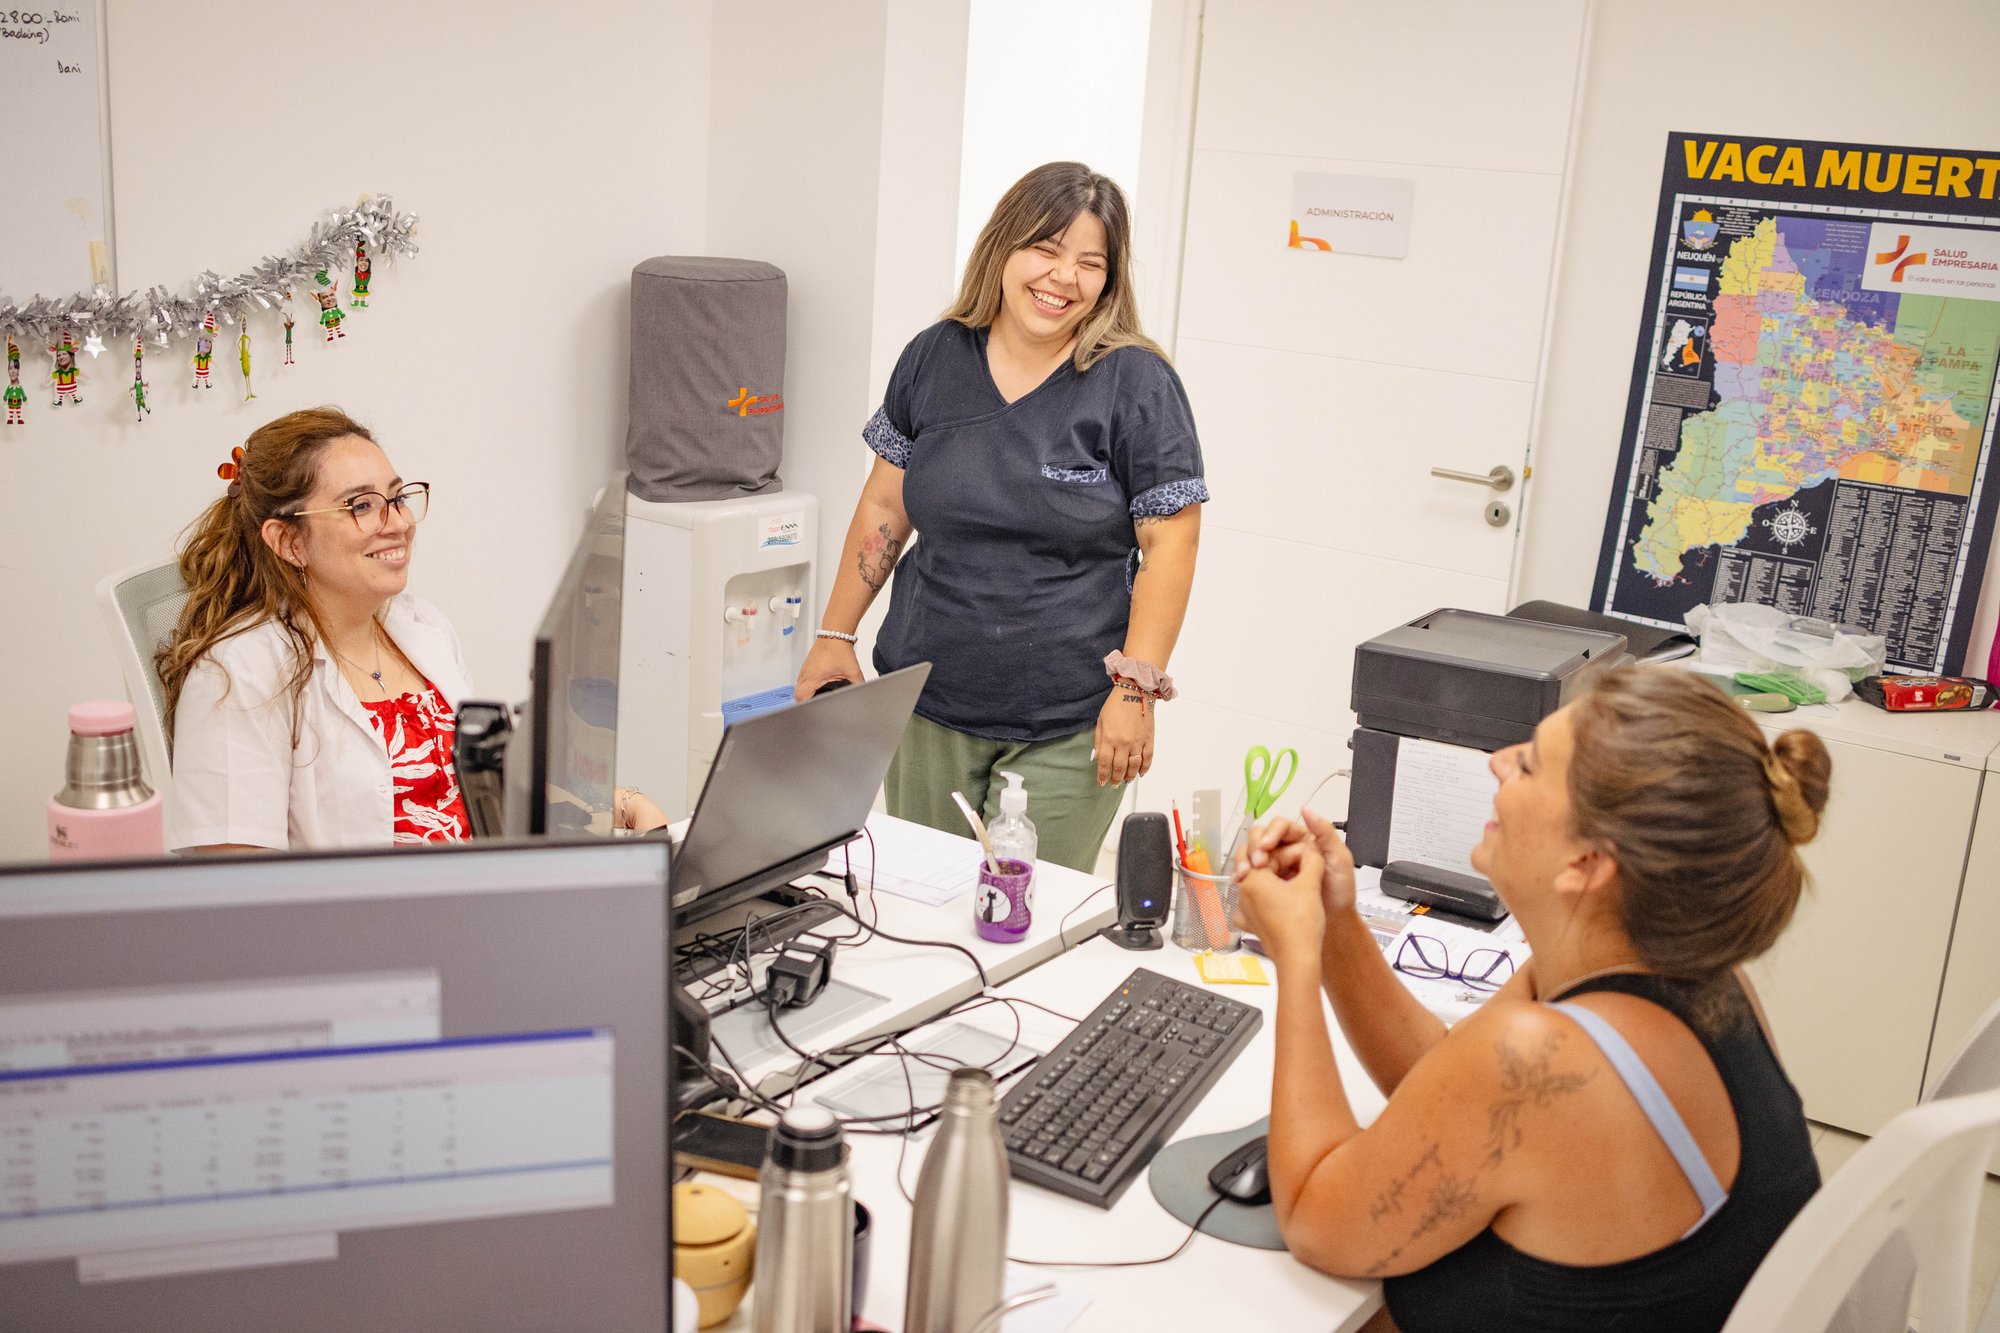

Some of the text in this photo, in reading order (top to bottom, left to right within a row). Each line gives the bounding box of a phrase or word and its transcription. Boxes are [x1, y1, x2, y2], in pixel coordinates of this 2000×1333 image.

[1684, 139, 2000, 200] VACA MUERT
[1676, 250, 1717, 263] NEUQUÉN
[1933, 248, 1968, 259] SALUD
[1670, 290, 1707, 301] REPÚBLICA
[1668, 299, 1707, 310] ARGENTINA
[1790, 499, 1800, 508] N
